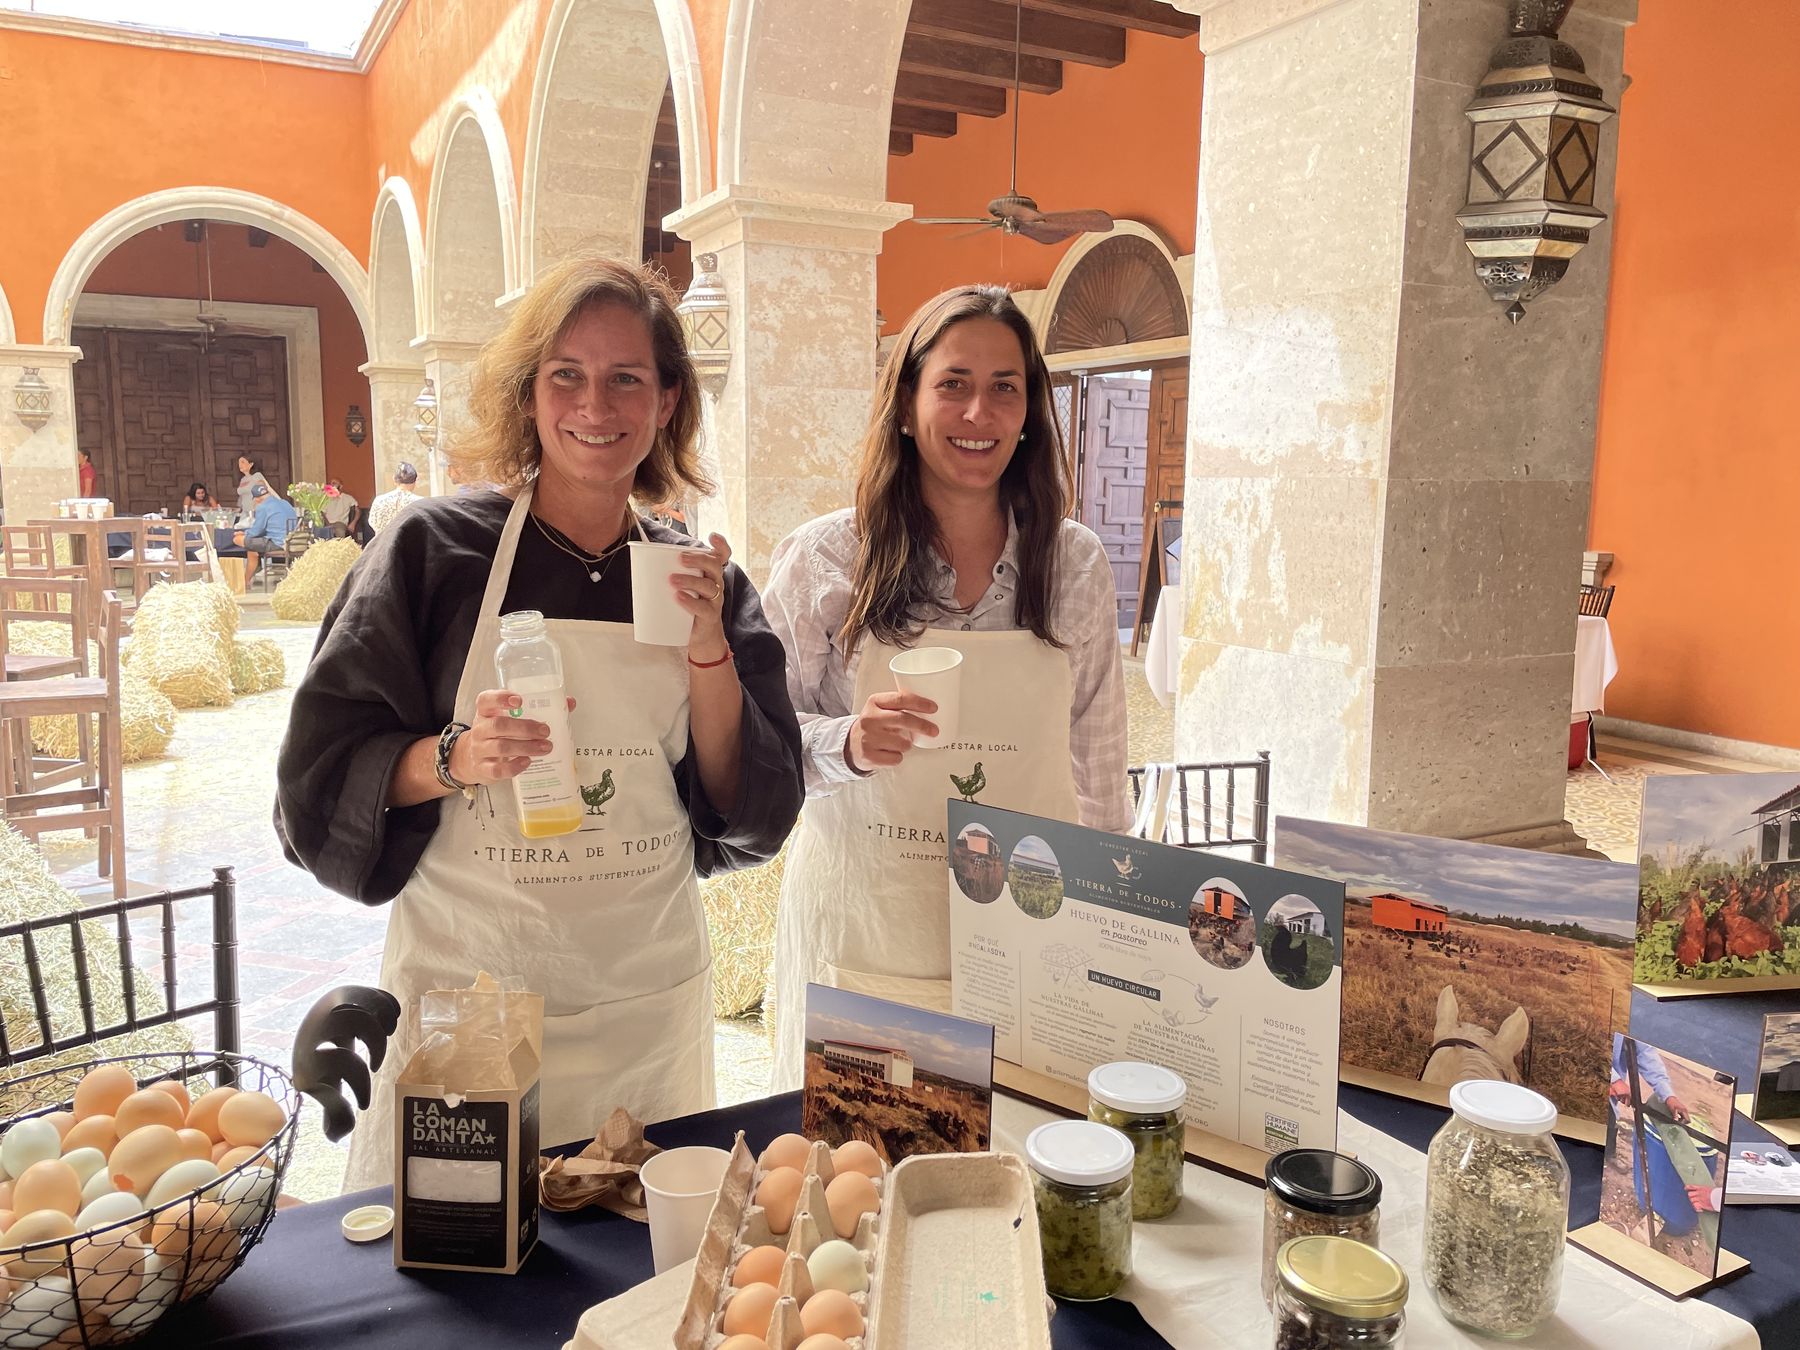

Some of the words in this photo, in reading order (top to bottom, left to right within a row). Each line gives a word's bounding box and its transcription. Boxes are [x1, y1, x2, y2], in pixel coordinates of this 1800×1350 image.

[576, 747, 613, 757] ESTAR
[619, 748, 655, 757] LOCAL
[988, 743, 1018, 752] LOCAL
[877, 823, 945, 843] TIERRA
[485, 846, 570, 863] TIERRA
[586, 846, 605, 858] DE
[622, 830, 678, 856] TODOS
[1131, 848, 1149, 857] LOCAL
[899, 852, 948, 862] ALIMENTO
[514, 873, 583, 885] ALIMENTOS
[589, 864, 661, 882] SUSTENTABLES
[1075, 878, 1113, 894] TIERRA
[1119, 889, 1129, 897] DE
[1135, 892, 1175, 910] TODOS
[1070, 908, 1107, 926] HUEVO
[1112, 918, 1126, 931] DE
[1130, 924, 1180, 945] GALLINA
[973, 934, 986, 943] POR
[1100, 928, 1110, 936] en
[1112, 931, 1148, 946] pastoreo
[968, 942, 1006, 958] #NOALASOYA
[1090, 973, 1100, 981] UN
[1101, 975, 1122, 989] HUEVO
[1124, 981, 1158, 999] CIRCULAR
[1040, 994, 1072, 1008] NUESTRAS
[1073, 1005, 1104, 1018] GALLINAS
[1053, 992, 1061, 1000] LA
[1064, 995, 1079, 1005] VIDA
[1081, 1000, 1089, 1008] DE
[1153, 1022, 1205, 1043] ALIMENTACIÓN
[1263, 1018, 1306, 1036] NOSOTROS
[1144, 1027, 1179, 1042] NUESTRAS
[1180, 1038, 1215, 1053] GALLINAS
[413, 1101, 440, 1117] LA
[412, 1115, 486, 1132] COMAN
[1266, 1114, 1298, 1129] CERTIFIED
[1266, 1121, 1297, 1136] HUMANE
[413, 1127, 485, 1145] DANTA
[413, 1144, 429, 1152] SAL
[435, 1145, 496, 1155] ARTESANAL
